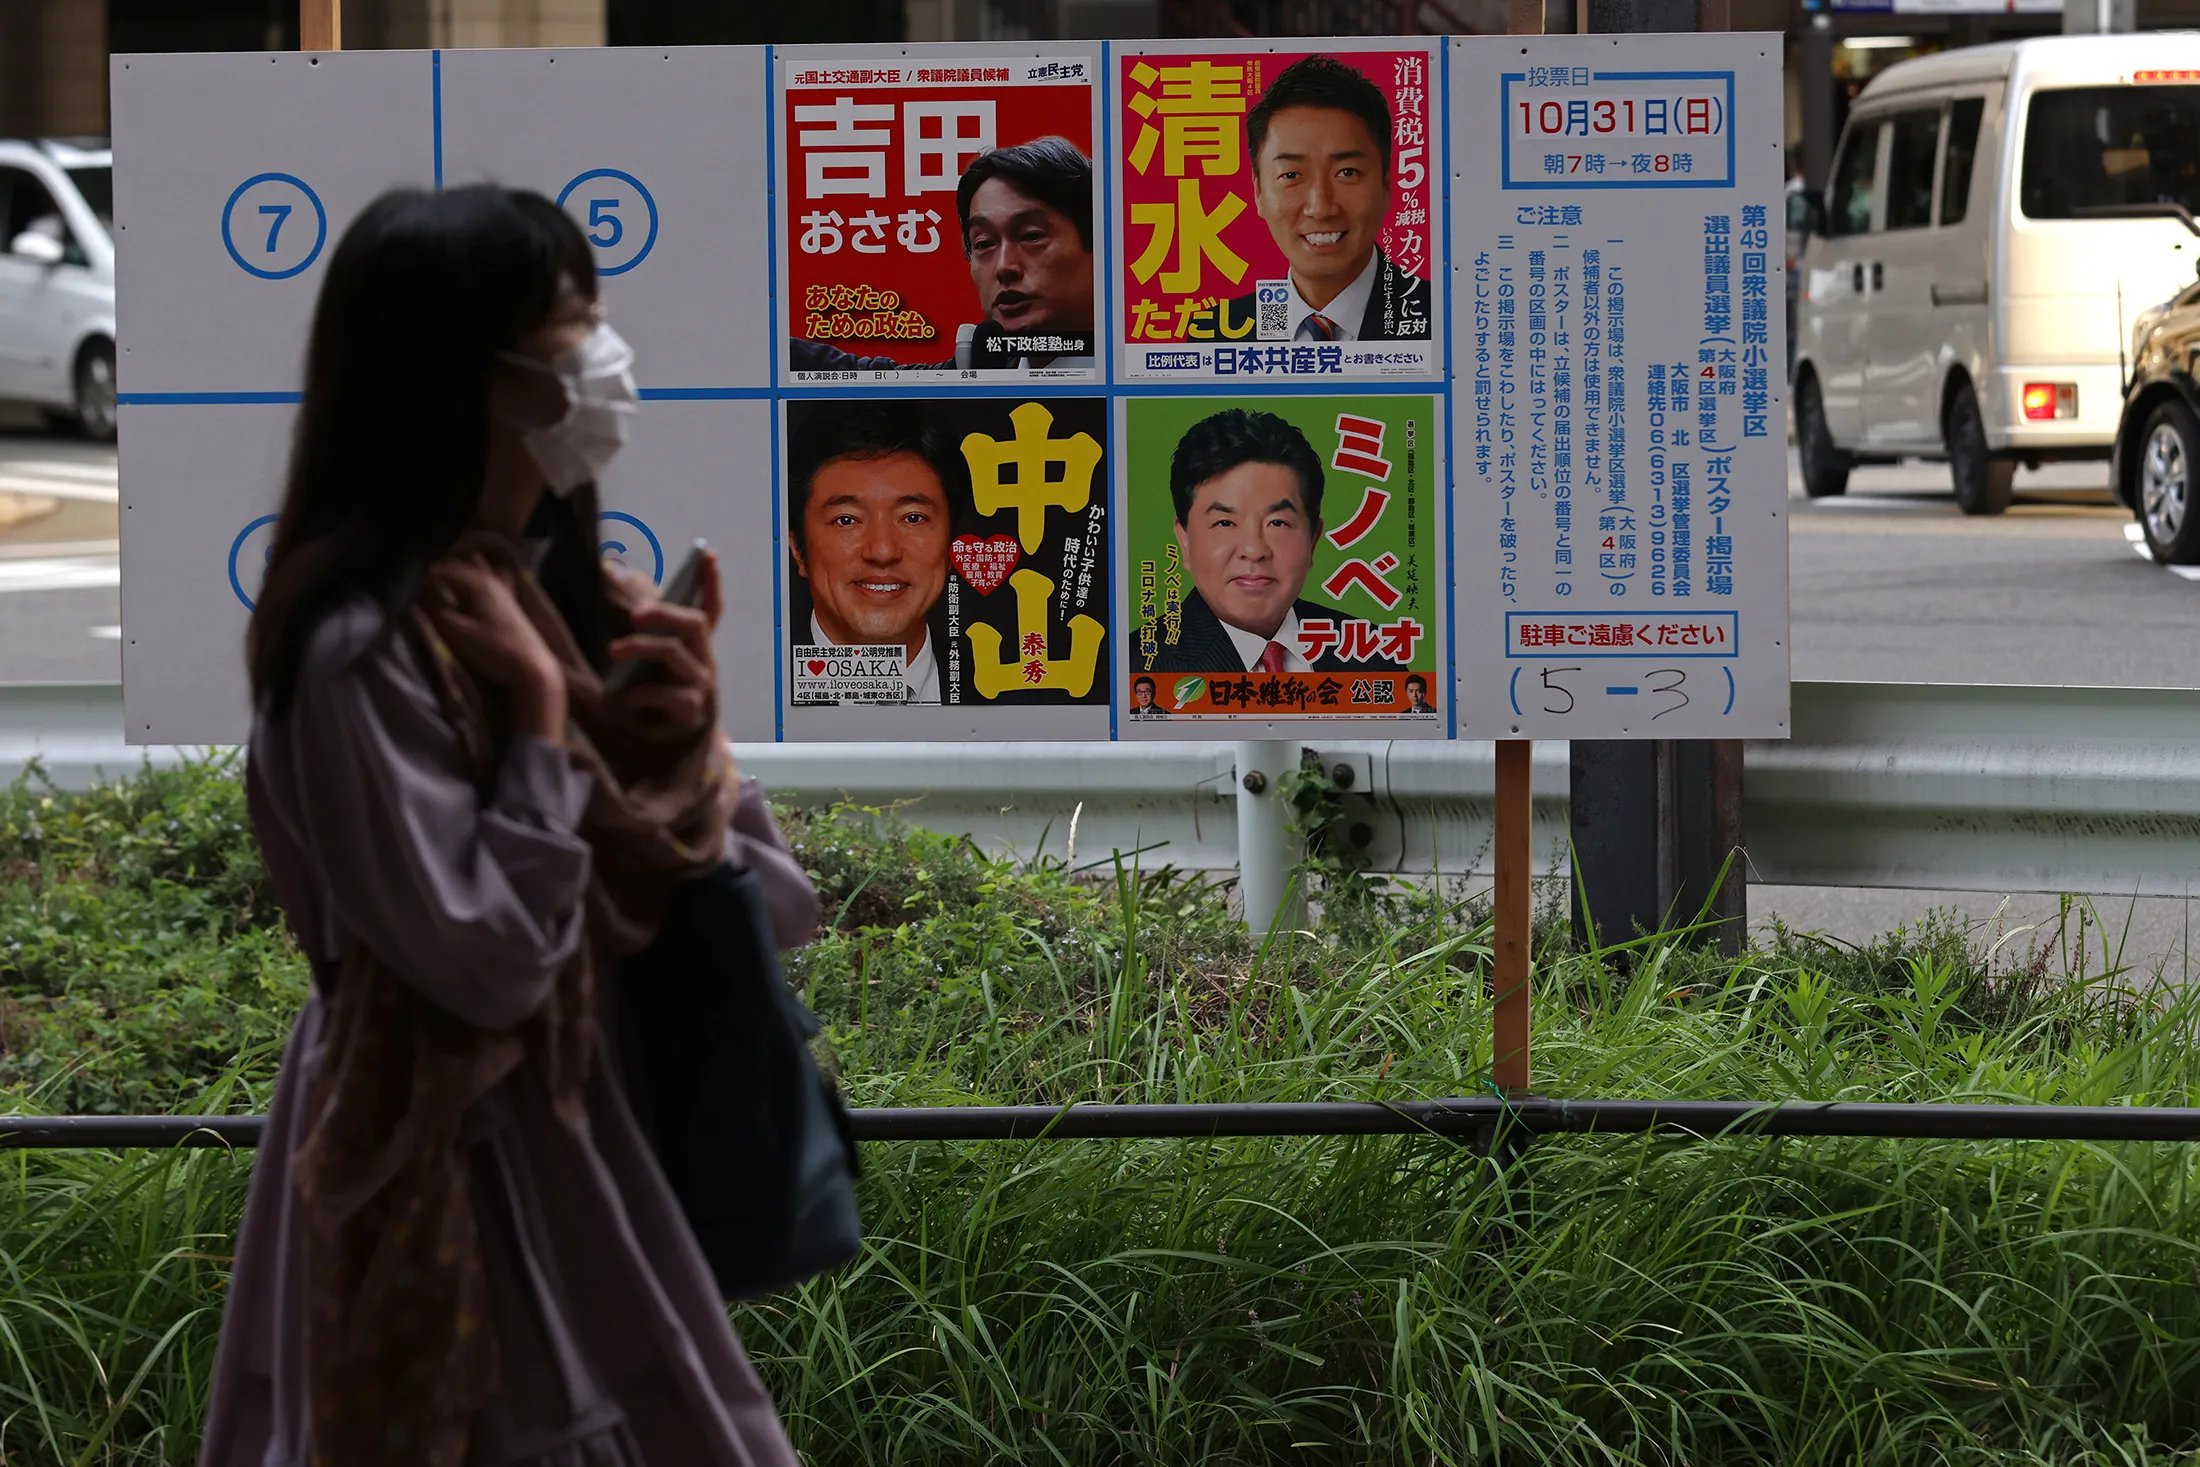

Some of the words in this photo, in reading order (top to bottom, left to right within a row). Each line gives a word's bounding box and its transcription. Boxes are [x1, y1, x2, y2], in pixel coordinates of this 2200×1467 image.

[794, 69, 900, 84] 元国土交通副大臣
[917, 68, 1010, 83] 衆議院議員候補
[1028, 63, 1084, 79] 立憲民主党
[1528, 67, 1589, 87] 投票日
[1519, 96, 1723, 137] 10月31日(日)
[794, 97, 997, 199] 吉田
[1127, 61, 1250, 295] 清水
[258, 205, 292, 253] 7
[588, 198, 624, 248] 5
[800, 209, 942, 254] おさむ
[1516, 205, 1583, 226] ご注意
[805, 284, 899, 310] あなたの
[1382, 228, 1395, 335] いのちを大切にする政治へ
[805, 311, 936, 339] ための政治。
[1131, 296, 1255, 340] ただし
[1740, 205, 1768, 437] 第49回衆議院小選挙区
[986, 336, 1085, 353] 松下政経塾出身
[960, 371, 977, 380] 会場
[1474, 252, 1492, 483] よごしたりすると罰せられます。
[1528, 251, 1547, 499] 番号の区画の中にはってください。
[1583, 249, 1602, 493] 候補者以外の方は使用できません。
[1321, 412, 1403, 611] ミノベ
[952, 540, 1017, 553] 命を守る政治
[960, 402, 1105, 700] 中山
[1075, 504, 1105, 608] かわいい子供達の
[795, 647, 853, 658] 自由民主党公認
[1296, 617, 1424, 664] テルオ
[1520, 624, 1725, 647] 駐車ご遠慮ください
[826, 660, 903, 677] OSAKA
[1020, 631, 1048, 685] 泰秀
[797, 680, 904, 692] www.iloveosaka.jp
[1209, 676, 1344, 711] 日本維新の会
[1350, 679, 1395, 705] 公認
